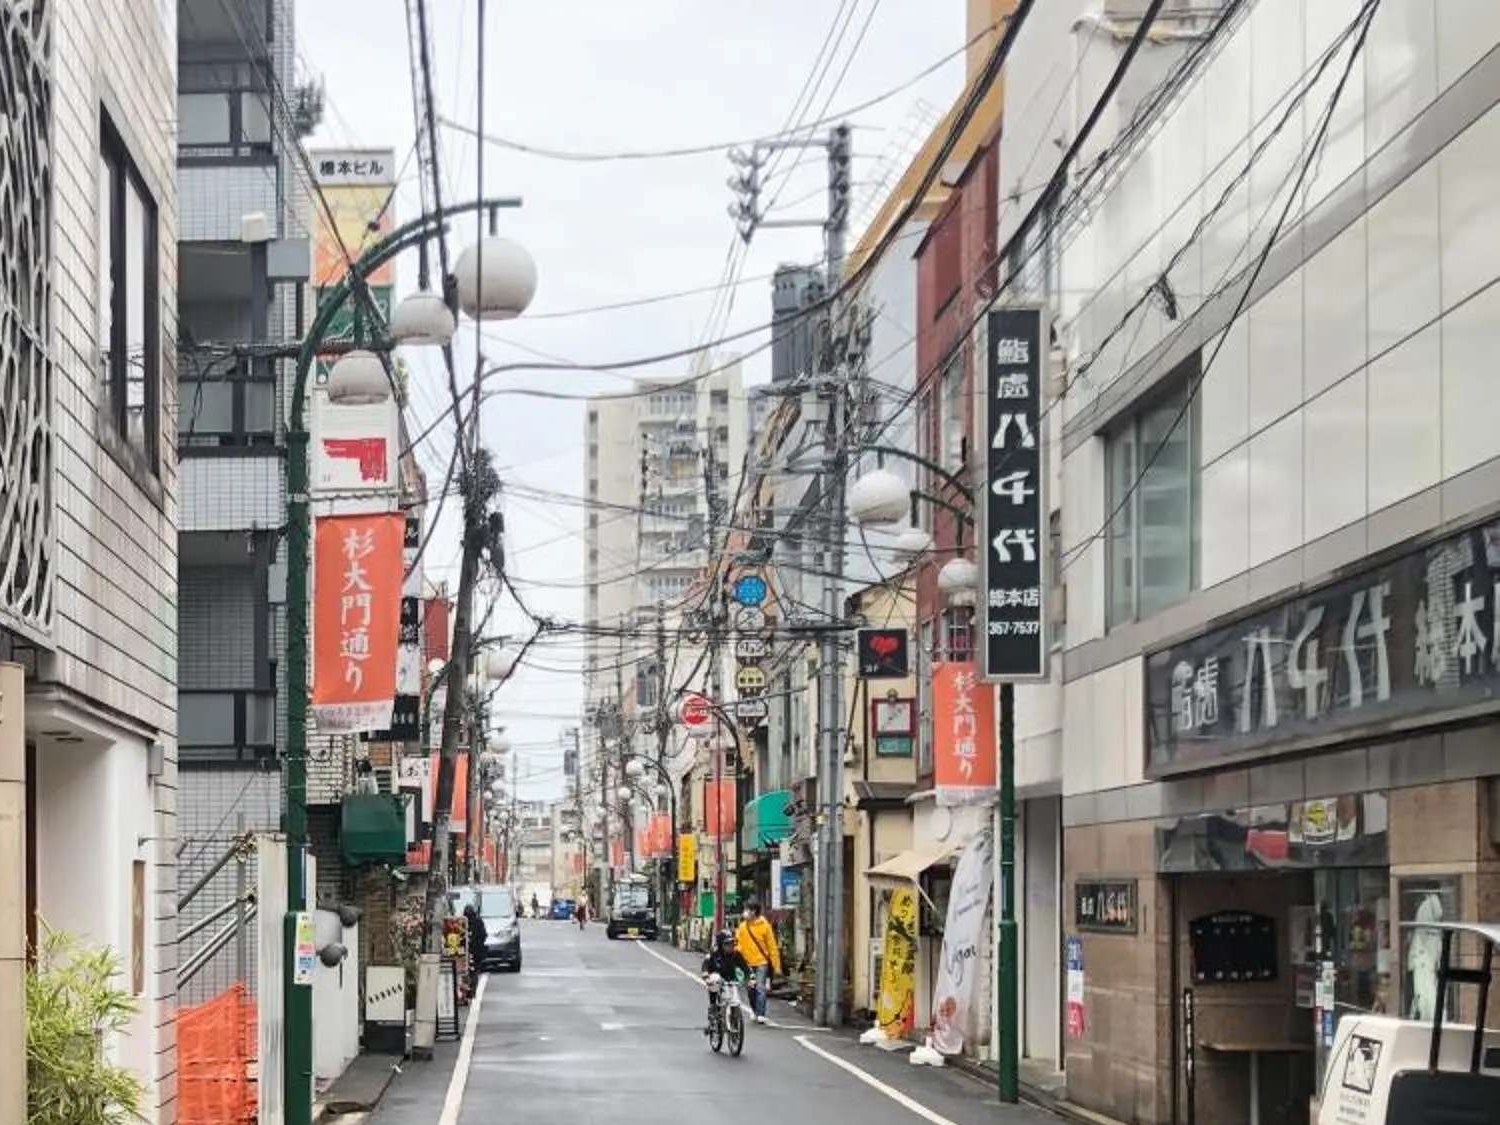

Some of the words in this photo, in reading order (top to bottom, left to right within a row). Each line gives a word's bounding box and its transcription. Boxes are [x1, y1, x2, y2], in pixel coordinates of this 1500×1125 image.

[340, 527, 377, 694] 杉大門通り
[951, 671, 978, 780] 杉大門通り
